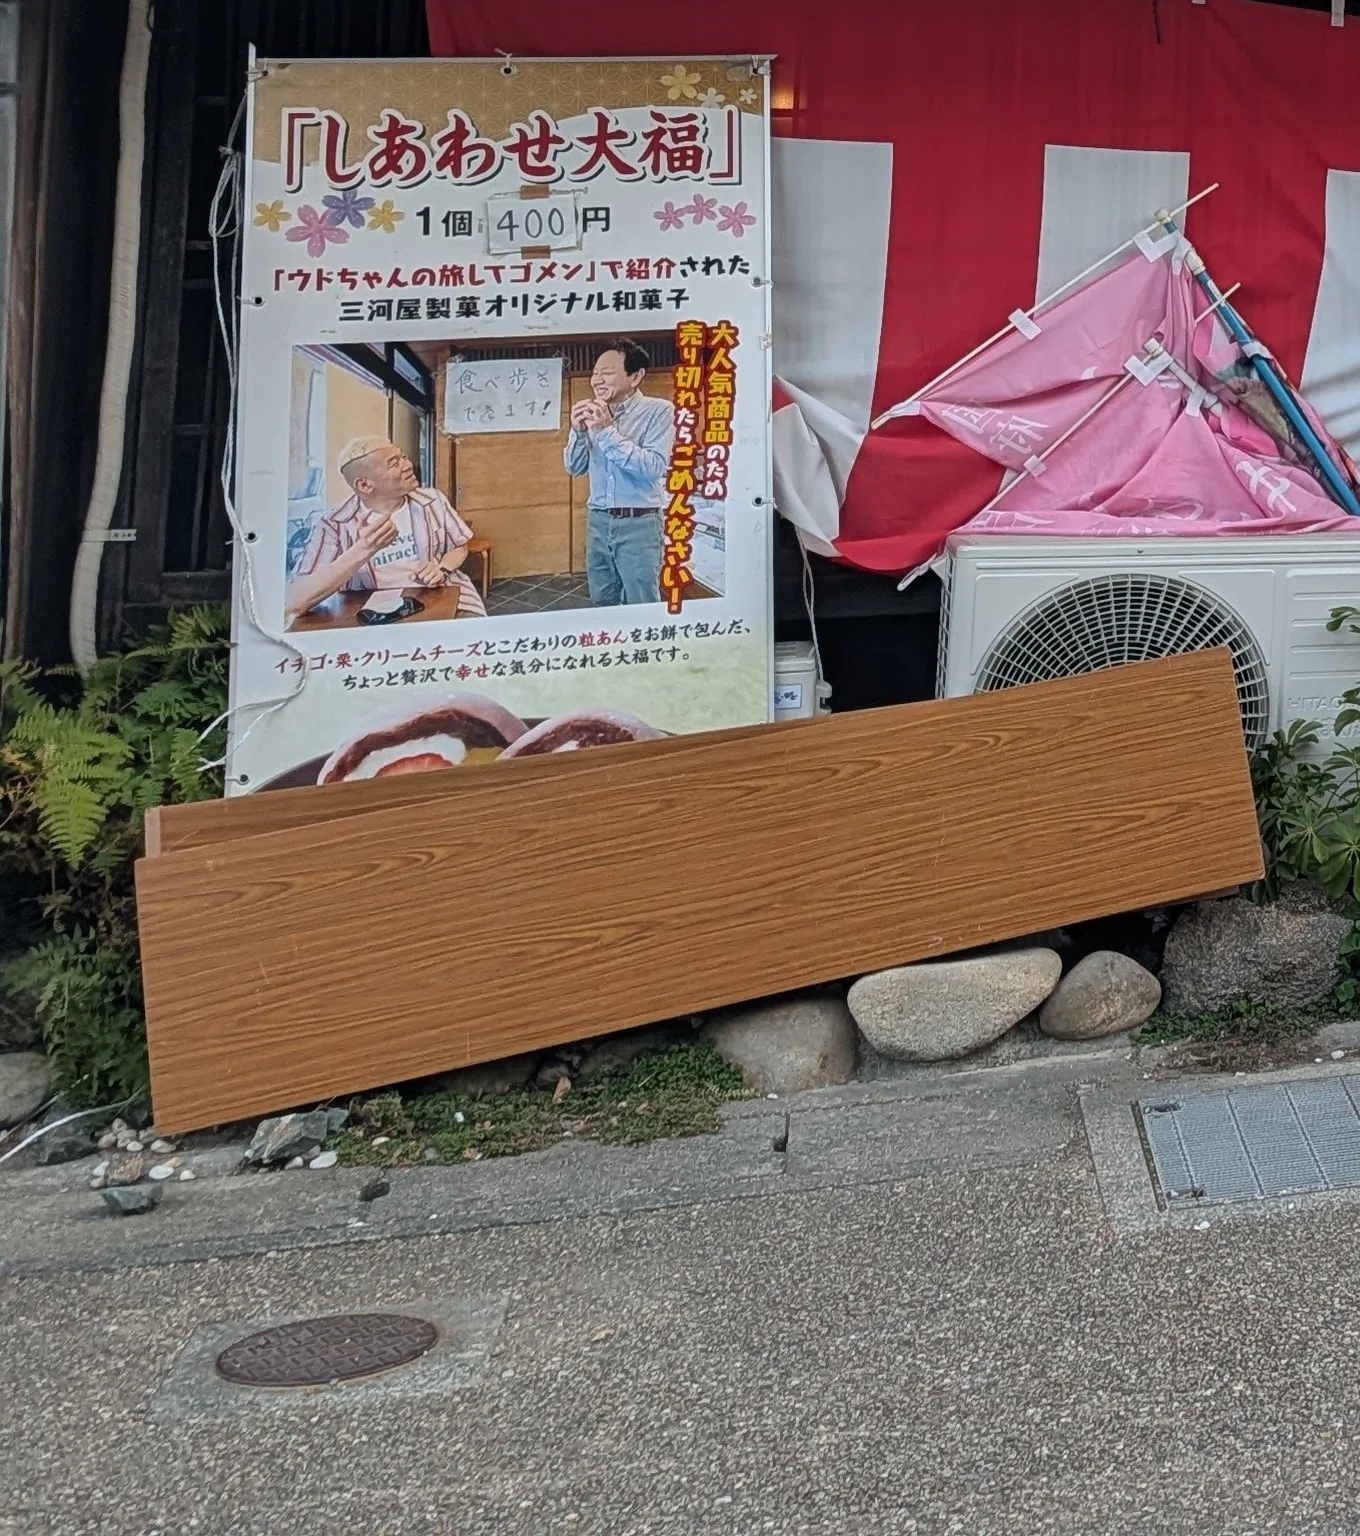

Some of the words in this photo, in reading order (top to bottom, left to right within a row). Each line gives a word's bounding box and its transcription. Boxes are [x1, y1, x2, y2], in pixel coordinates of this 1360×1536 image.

[285, 107, 742, 190] 「しあわせ大福」
[273, 255, 751, 292] 「ウドちゃんの旅してゴメン」で紹介された
[338, 289, 690, 321] 三河屋製菓オリジナル和菓子
[455, 367, 550, 395] 食べ歩き
[704, 323, 739, 497] 大人気商品のため
